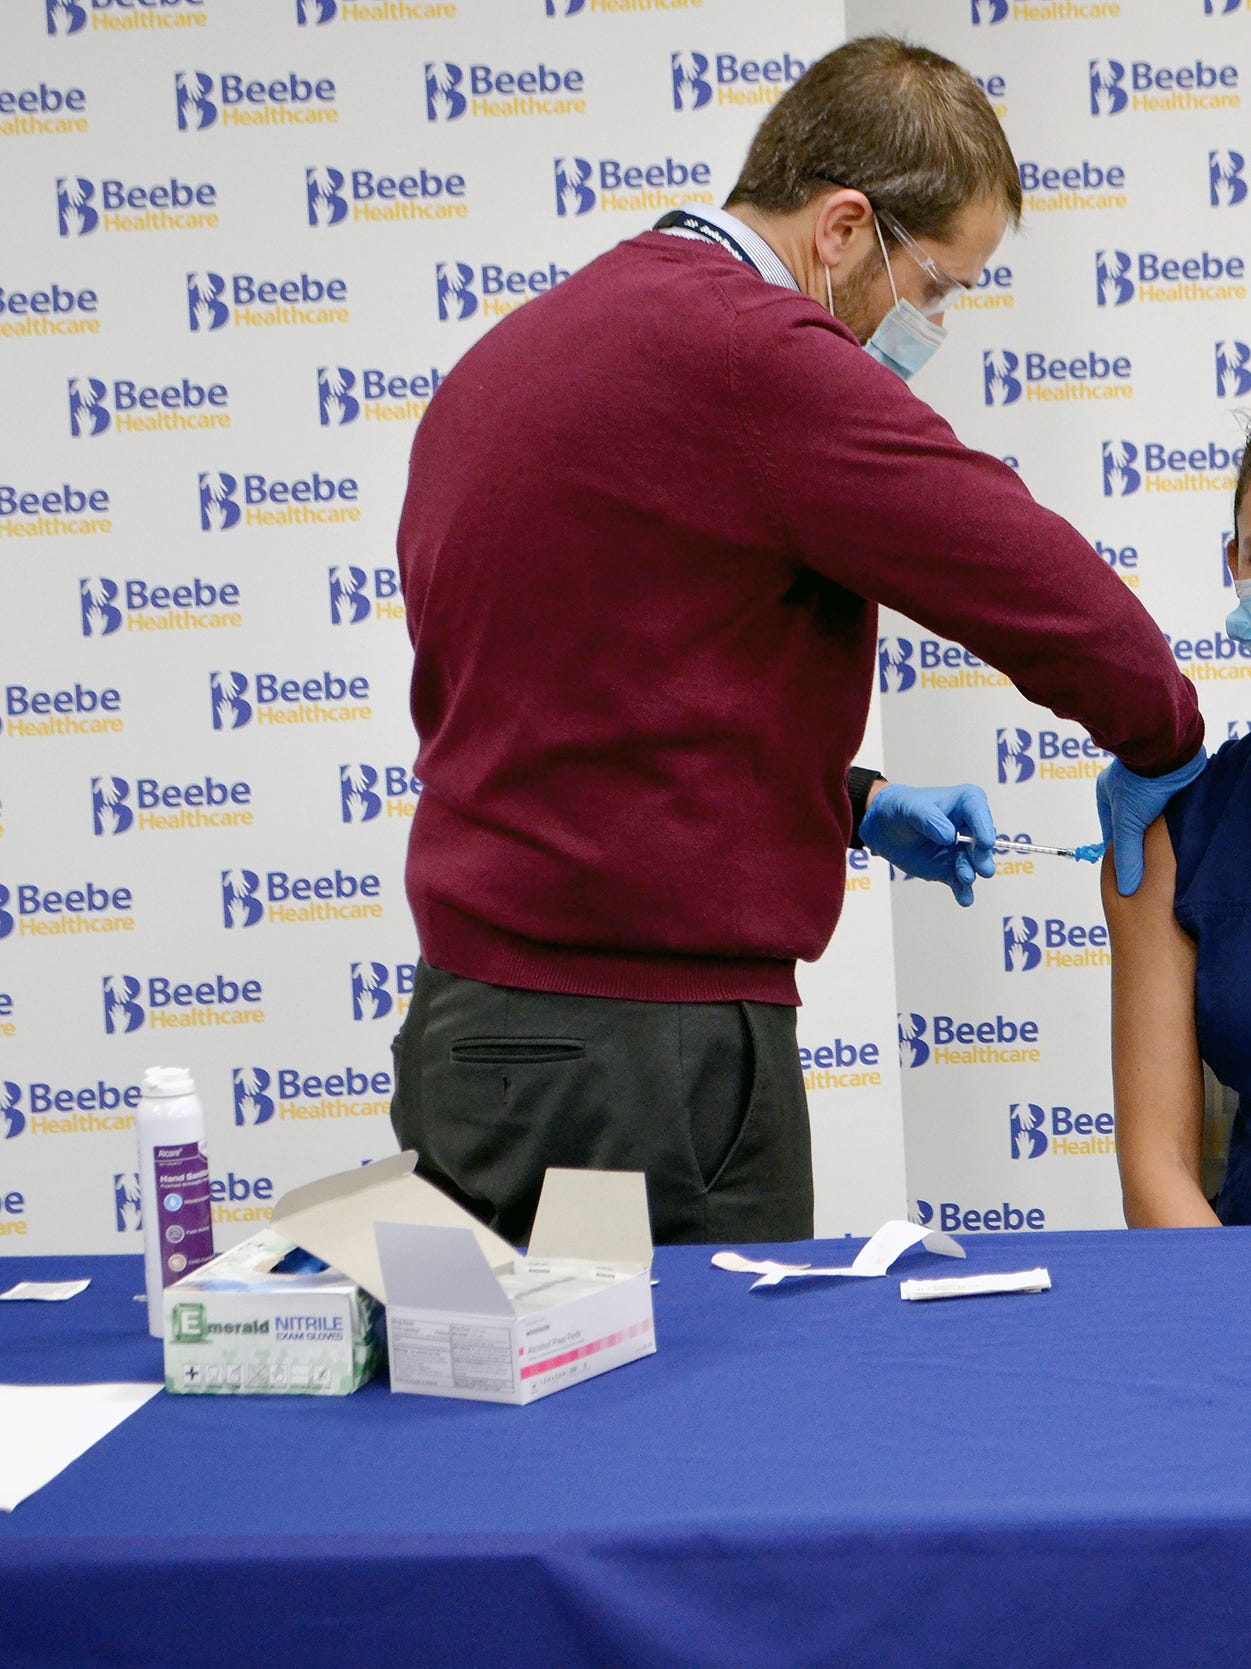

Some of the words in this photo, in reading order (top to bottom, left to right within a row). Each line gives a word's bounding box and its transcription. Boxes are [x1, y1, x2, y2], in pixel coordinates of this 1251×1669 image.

[92, 10, 207, 30] Healthcare
[342, 0, 457, 21] Healthcare
[470, 64, 583, 95] Beebe
[1132, 60, 1238, 90] Beebe
[221, 73, 335, 105] Beebe
[472, 96, 587, 117] Healthcare
[1133, 91, 1241, 112] Healthcare
[222, 105, 338, 126] Healthcare
[352, 168, 464, 200] Beebe
[599, 158, 710, 189] Beebe
[1019, 160, 1125, 190] Beebe
[102, 177, 216, 210] Beebe
[1021, 192, 1127, 212] Healthcare
[104, 210, 219, 232] Healthcare
[353, 201, 468, 222] Healthcare
[1139, 252, 1244, 281] Beebe
[232, 273, 347, 305] Beebe
[1139, 282, 1247, 302] Healthcare
[235, 305, 350, 327] Healthcare
[1026, 351, 1131, 381] Beebe
[114, 379, 228, 411] Beebe
[1027, 382, 1134, 401] Healthcare
[116, 411, 230, 431] Healthcare
[244, 473, 358, 505] Beebe
[246, 505, 361, 526] Healthcare
[126, 578, 239, 610] Beebe
[128, 610, 242, 631] Healthcare
[256, 671, 369, 704] Beebe
[6, 683, 120, 716] Beebe
[257, 703, 372, 725] Healthcare
[8, 715, 123, 736] Healthcare
[137, 776, 251, 809] Beebe
[139, 809, 253, 830] Healthcare
[267, 869, 380, 902] Beebe
[17, 882, 132, 915] Beebe
[269, 902, 383, 923] Healthcare
[20, 915, 134, 936] Healthcare
[148, 975, 262, 1007] Beebe
[150, 1007, 264, 1029] Healthcare
[933, 1015, 1039, 1045] Beebe
[934, 1045, 1040, 1065] Healthcare
[278, 1067, 391, 1100] Beebe
[280, 1099, 391, 1120] Healthcare
[160, 1174, 185, 1182] Hand
[940, 1202, 1045, 1232] Beebe
[177, 1306, 270, 1339] Emerald
[275, 1316, 344, 1331] NITRILE
[275, 1332, 304, 1341] EXAM
[307, 1332, 344, 1341] GLOVES
